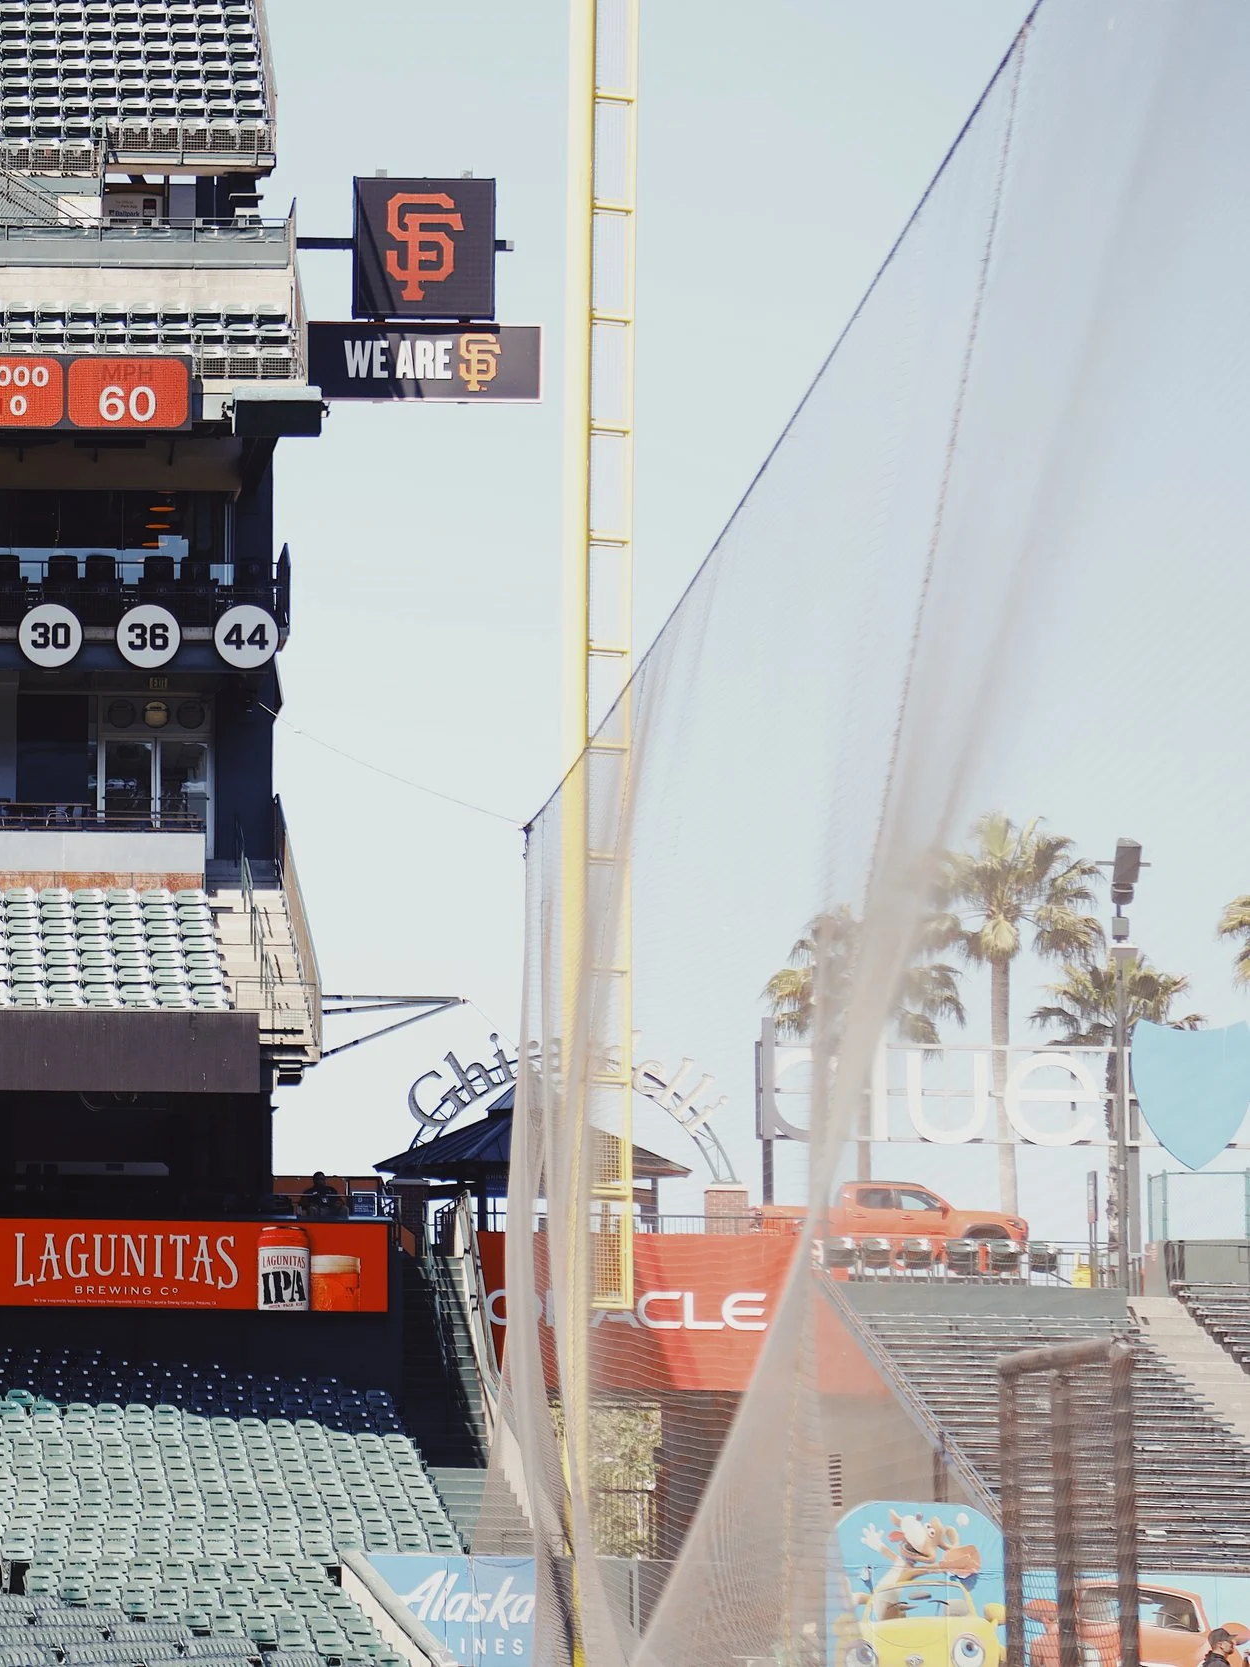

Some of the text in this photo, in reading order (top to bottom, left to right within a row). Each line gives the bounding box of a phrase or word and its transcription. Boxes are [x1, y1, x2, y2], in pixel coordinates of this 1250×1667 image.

[386, 192, 464, 301] SF
[102, 363, 151, 382] MPH
[343, 340, 390, 379] WE
[395, 340, 454, 380] ARE
[9, 395, 28, 417] 0
[98, 385, 157, 422] 60
[30, 622, 71, 649] 30
[127, 623, 170, 650] 36
[223, 623, 270, 650] 44
[14, 1232, 240, 1290] LAGUNITAS
[262, 1255, 306, 1269] LAGUNITAS
[74, 1285, 152, 1296] BREWING
[261, 1269, 307, 1305] IPA
[400, 1569, 535, 1631] Alaska
